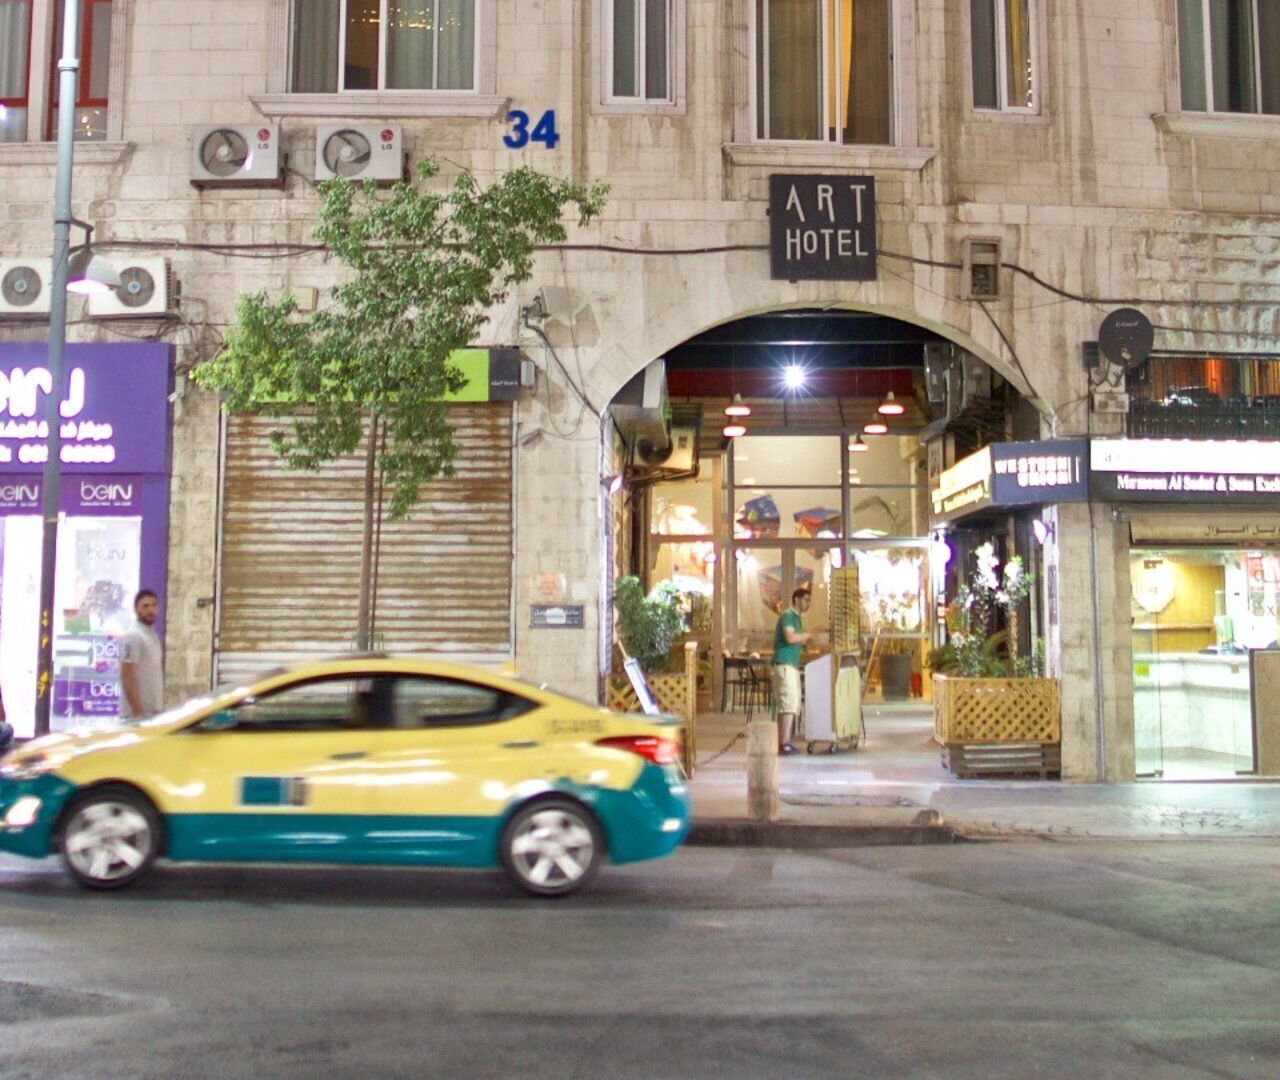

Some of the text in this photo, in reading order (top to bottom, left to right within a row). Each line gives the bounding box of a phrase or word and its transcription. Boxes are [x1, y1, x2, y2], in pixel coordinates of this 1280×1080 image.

[503, 110, 561, 150] 34
[785, 183, 867, 224] ART
[785, 228, 869, 261] HOTEL
